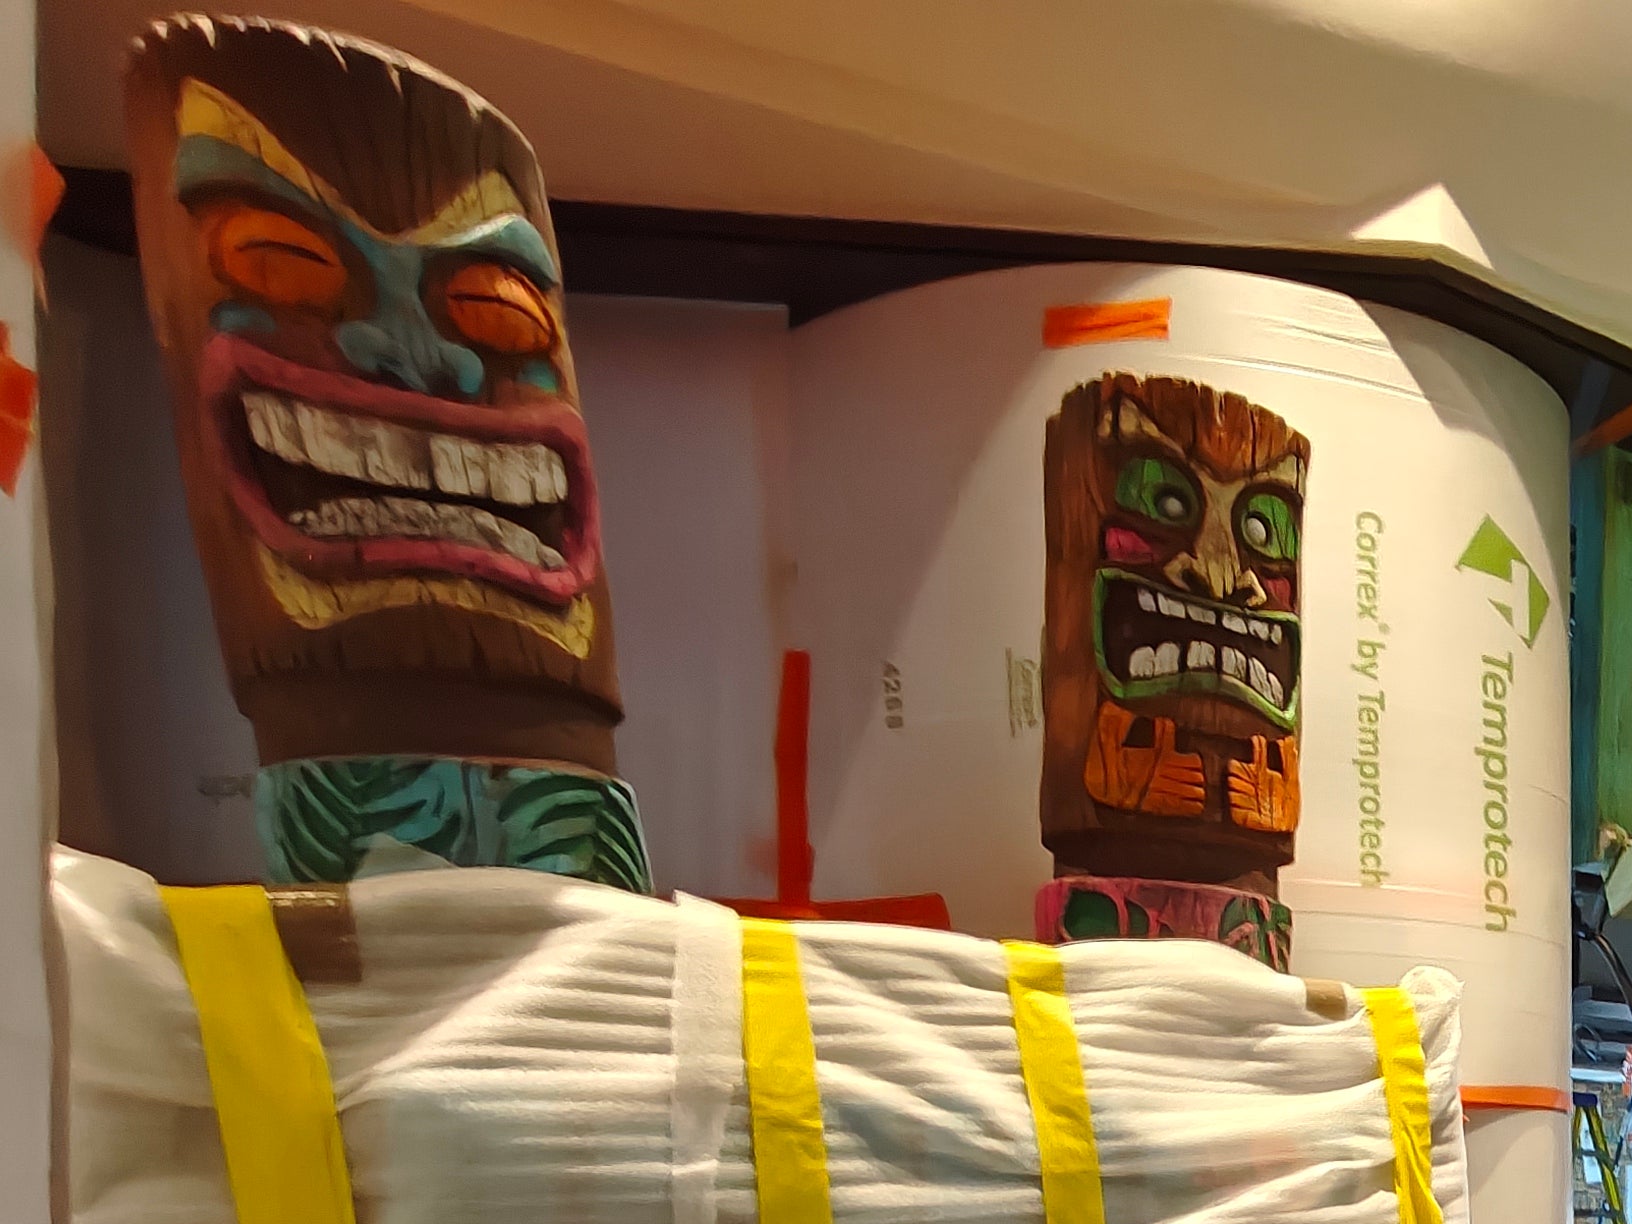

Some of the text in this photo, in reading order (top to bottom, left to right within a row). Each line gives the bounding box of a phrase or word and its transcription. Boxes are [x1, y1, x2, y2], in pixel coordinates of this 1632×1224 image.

[1351, 640, 1387, 680] by
[1352, 690, 1390, 886] Temprotech
[1474, 652, 1518, 932] Temprotech
